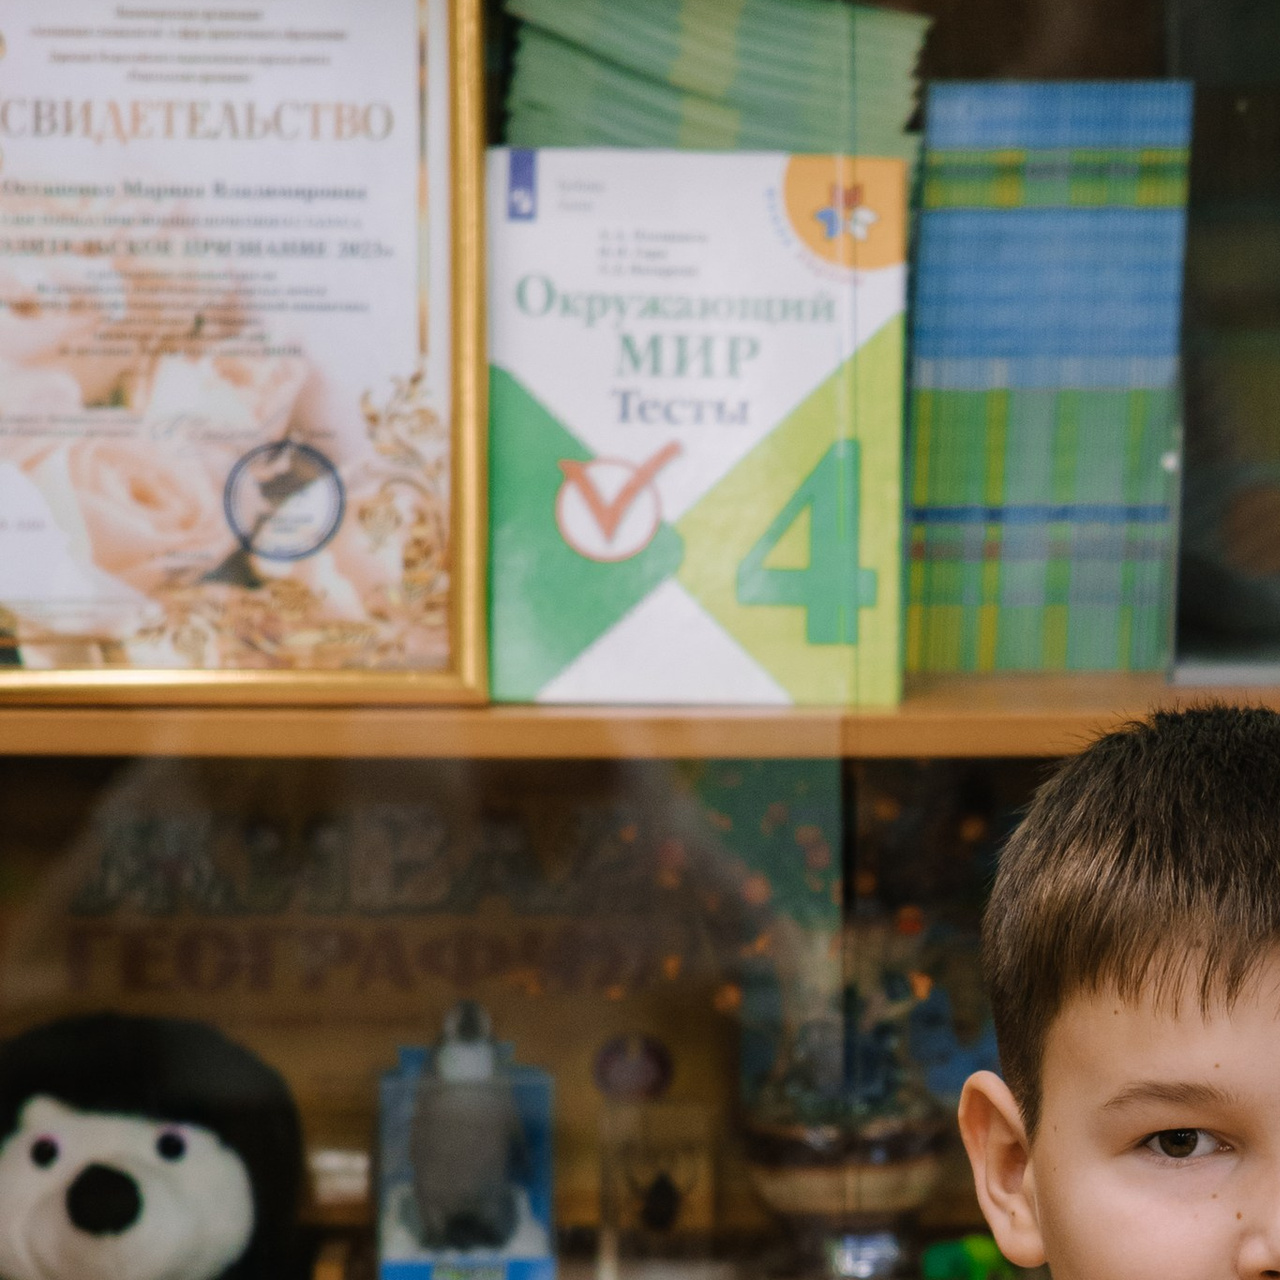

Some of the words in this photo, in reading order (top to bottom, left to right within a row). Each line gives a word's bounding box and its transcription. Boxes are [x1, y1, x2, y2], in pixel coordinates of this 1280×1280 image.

[0, 100, 395, 145] СВИДЕТЕЛЬСТВО
[515, 275, 836, 327] Окружающий
[616, 333, 760, 379] МИР
[611, 388, 750, 426] Тесты
[736, 437, 877, 645] 4
